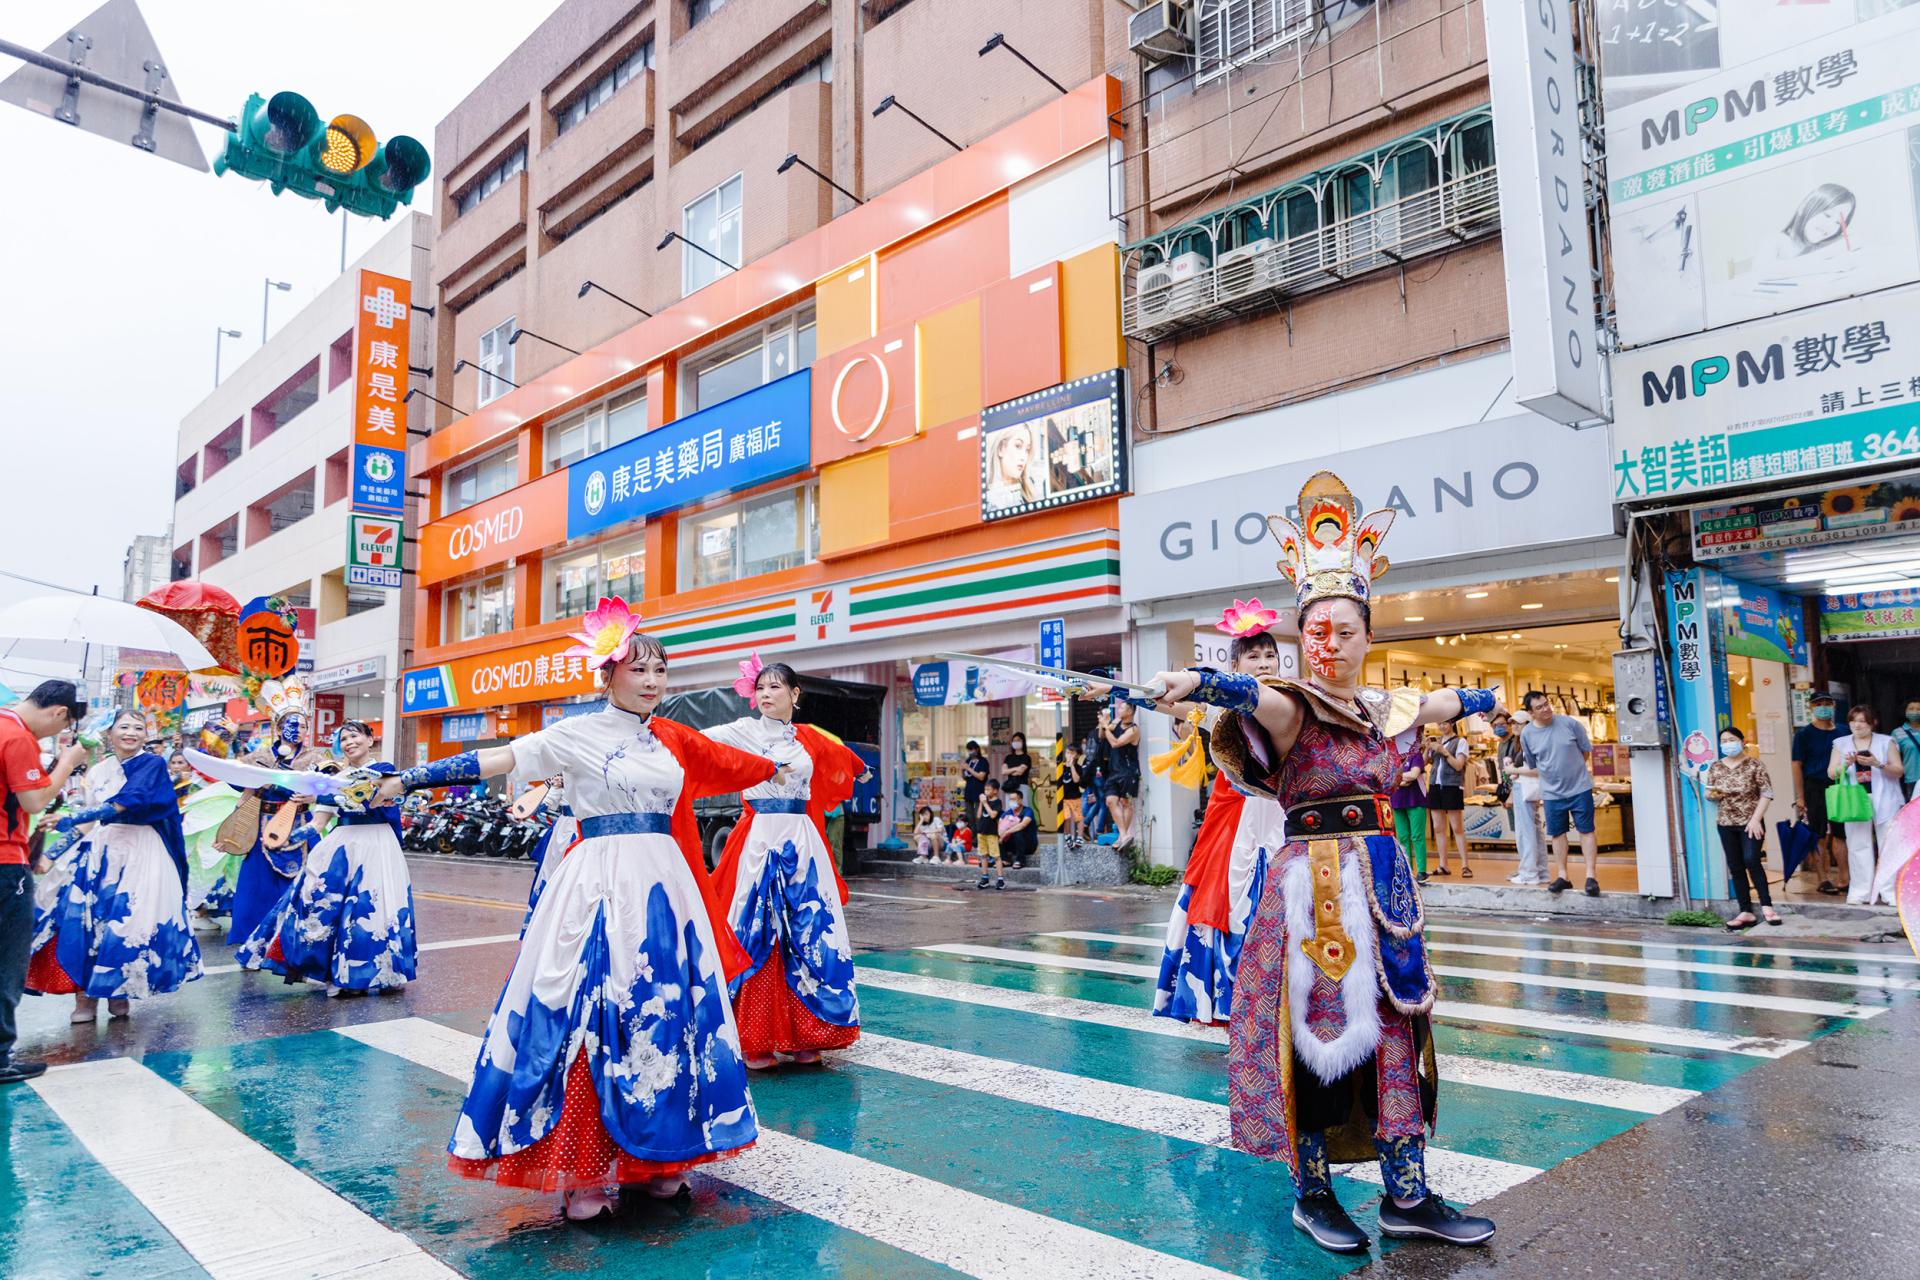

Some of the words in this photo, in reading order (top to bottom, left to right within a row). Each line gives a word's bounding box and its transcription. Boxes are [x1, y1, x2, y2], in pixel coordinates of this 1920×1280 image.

[1604, 21, 1690, 46] 1+1=2
[1641, 80, 1766, 151] MPM
[1773, 48, 1858, 107] 數學
[1538, 0, 1582, 368] GIORDANO
[367, 341, 398, 436] 康是美
[1642, 344, 1785, 407] MPM
[1792, 320, 1890, 377] 數學
[611, 428, 723, 503] 康是美藥局
[729, 420, 782, 464] 廣福店
[1614, 433, 1727, 498] 大智美語
[448, 506, 523, 560] COSMED
[1159, 461, 1540, 562] GIOANO
[811, 590, 833, 640] 7
[246, 627, 293, 669] 雨
[472, 661, 532, 694] COSMED
[534, 652, 583, 686] 康是美
[1679, 642, 1701, 682] 數學
[318, 709, 336, 735] P
